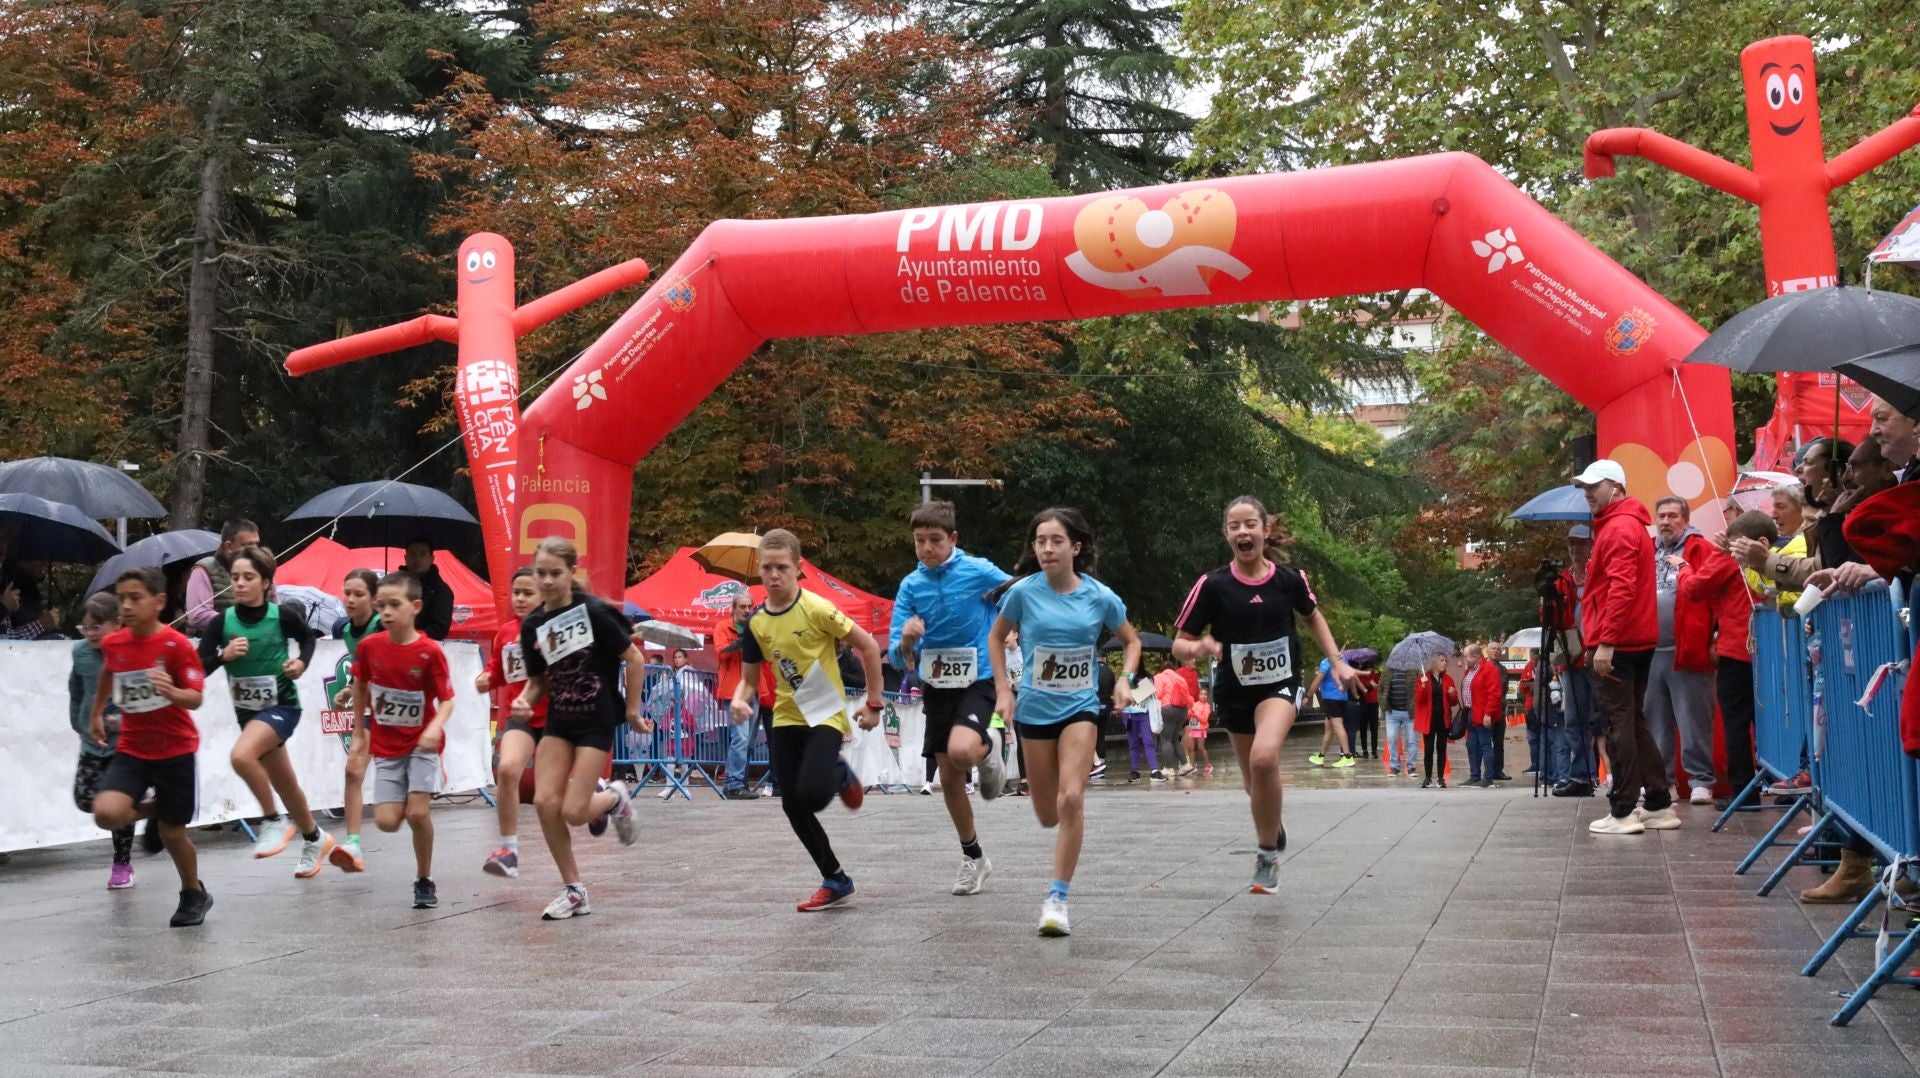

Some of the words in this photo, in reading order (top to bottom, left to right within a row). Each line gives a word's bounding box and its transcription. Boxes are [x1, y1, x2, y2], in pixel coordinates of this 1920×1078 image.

[897, 203, 1043, 252] PMD
[897, 255, 1040, 282] Ayuntamiento
[900, 281, 929, 303] de
[937, 279, 1047, 303] Palencia
[1524, 262, 1565, 292] Patronato
[1565, 288, 1607, 319] Municipal
[1532, 282, 1544, 292] de
[1544, 288, 1583, 317] Deportes
[1511, 279, 1554, 310] Ayuntamiento
[1554, 308, 1563, 317] de
[1564, 313, 1592, 336] Palencia
[603, 340, 634, 370] Patronato
[632, 309, 662, 341] Municipal
[621, 355, 630, 365] de
[628, 327, 657, 357] Deportes
[473, 410, 493, 452] CIA
[487, 407, 509, 453] LEN
[500, 406, 516, 437] PA
[521, 475, 591, 493] Palencia
[557, 621, 588, 645] 273
[942, 662, 972, 676] 287
[1055, 662, 1089, 679] 208
[1254, 653, 1286, 672] 300
[243, 688, 273, 701] 243
[384, 702, 420, 717] 270
